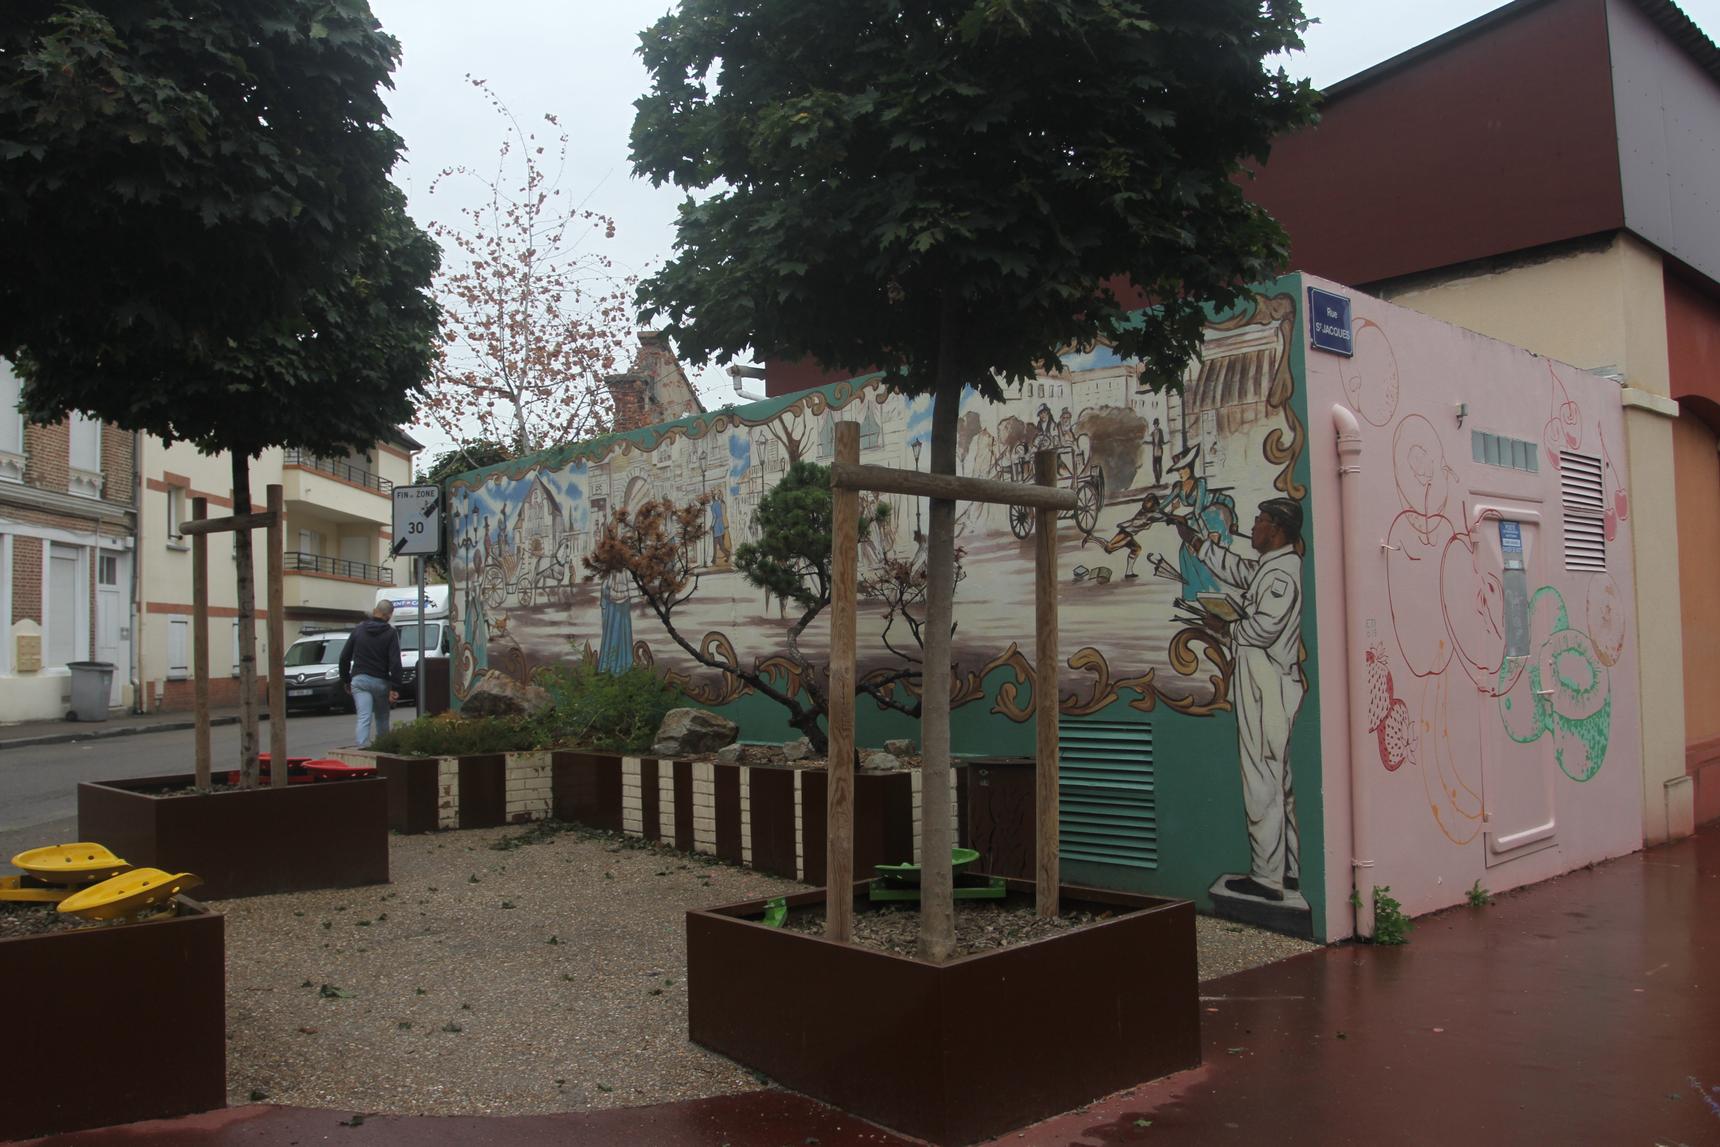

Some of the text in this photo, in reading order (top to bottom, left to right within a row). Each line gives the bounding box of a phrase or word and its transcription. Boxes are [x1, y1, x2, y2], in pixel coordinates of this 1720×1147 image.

[1326, 307, 1338, 319] Rue
[1322, 324, 1351, 340] JACQUES
[397, 491, 409, 499] FIN
[416, 490, 435, 498] ZONE
[408, 522, 424, 534] 30
